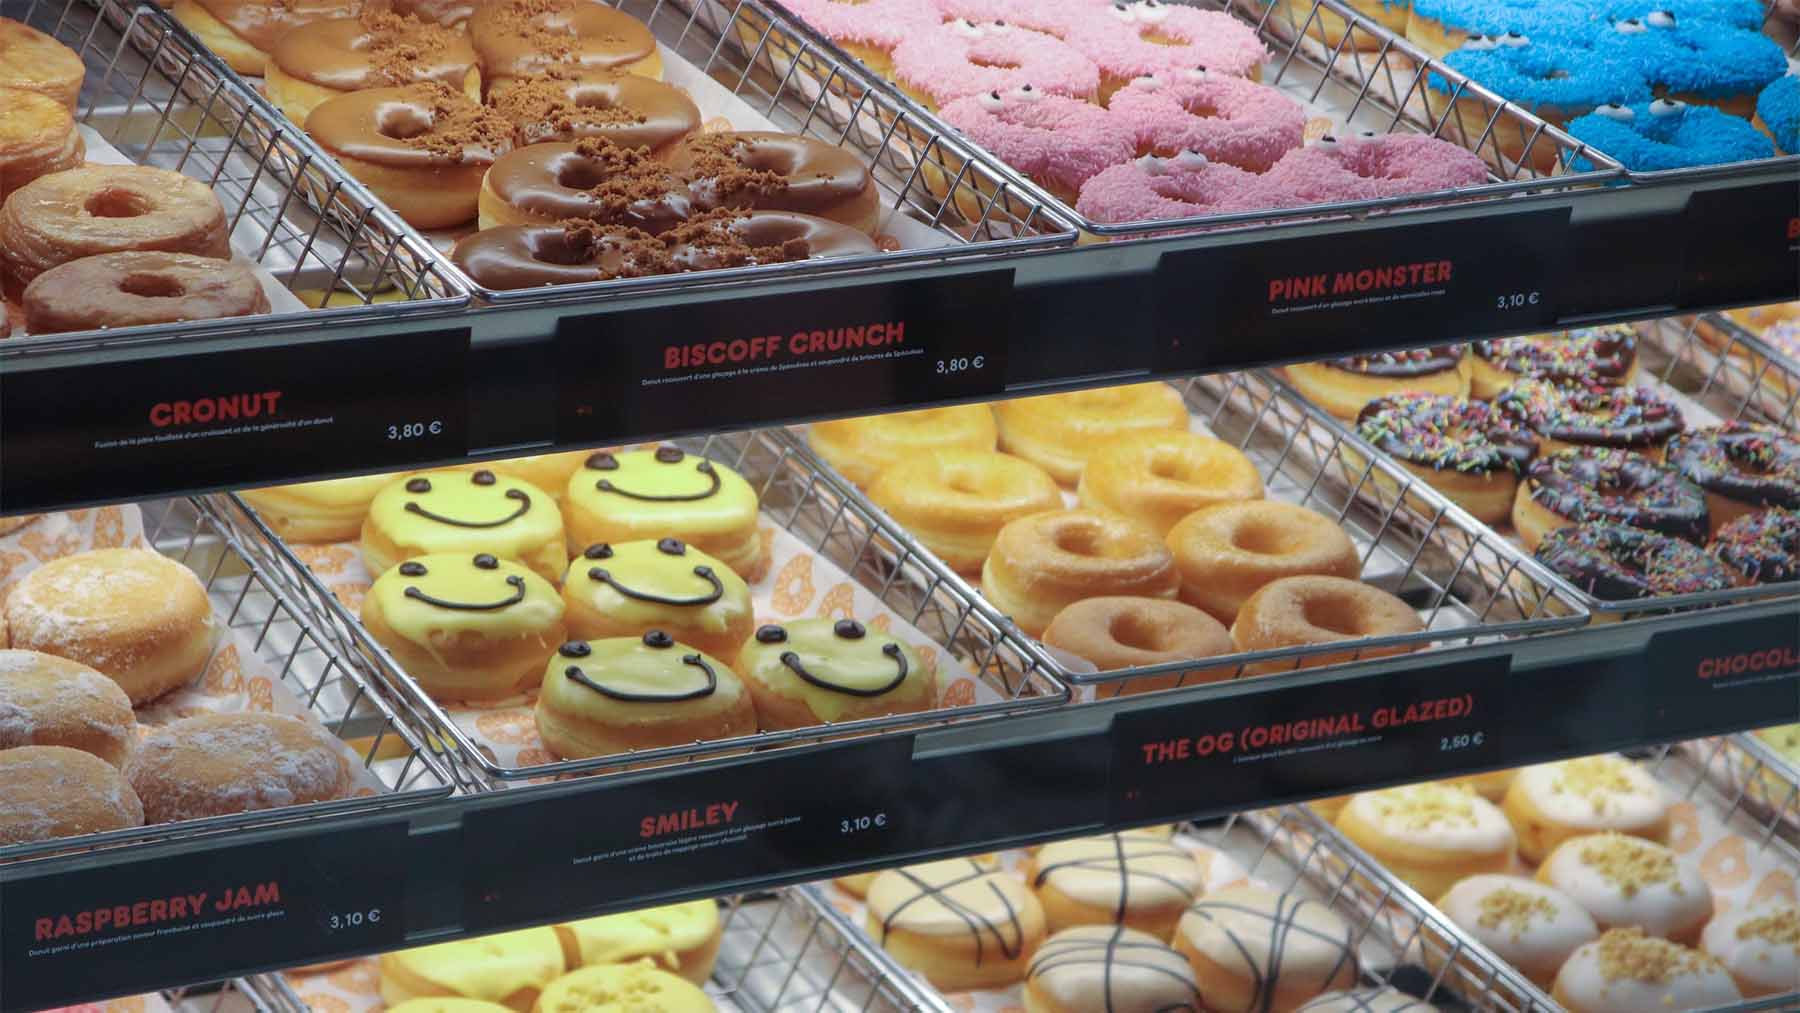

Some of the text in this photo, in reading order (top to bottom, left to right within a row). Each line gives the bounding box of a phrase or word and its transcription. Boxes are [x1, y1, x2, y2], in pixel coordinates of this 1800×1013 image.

[1267, 260, 1453, 302] PINK MONSTER
[1496, 291, 1541, 310] 3,10 €
[664, 321, 905, 368] BISCOFF CRUNCH
[936, 355, 985, 374] 3,80 €
[149, 391, 282, 428] CRONUT
[388, 420, 442, 440] 3,80 €
[1141, 739, 1191, 764] THE
[1196, 732, 1233, 756] OG
[1241, 712, 1367, 752] (ORIGINAL
[1371, 694, 1473, 729] GLAZED)
[1440, 731, 1484, 751] 2,50 €
[640, 801, 739, 838] SMILEY
[841, 814, 887, 832] 3,10 €
[35, 881, 280, 940] RASPBERRY JAM
[330, 908, 381, 928] 3,10 €
